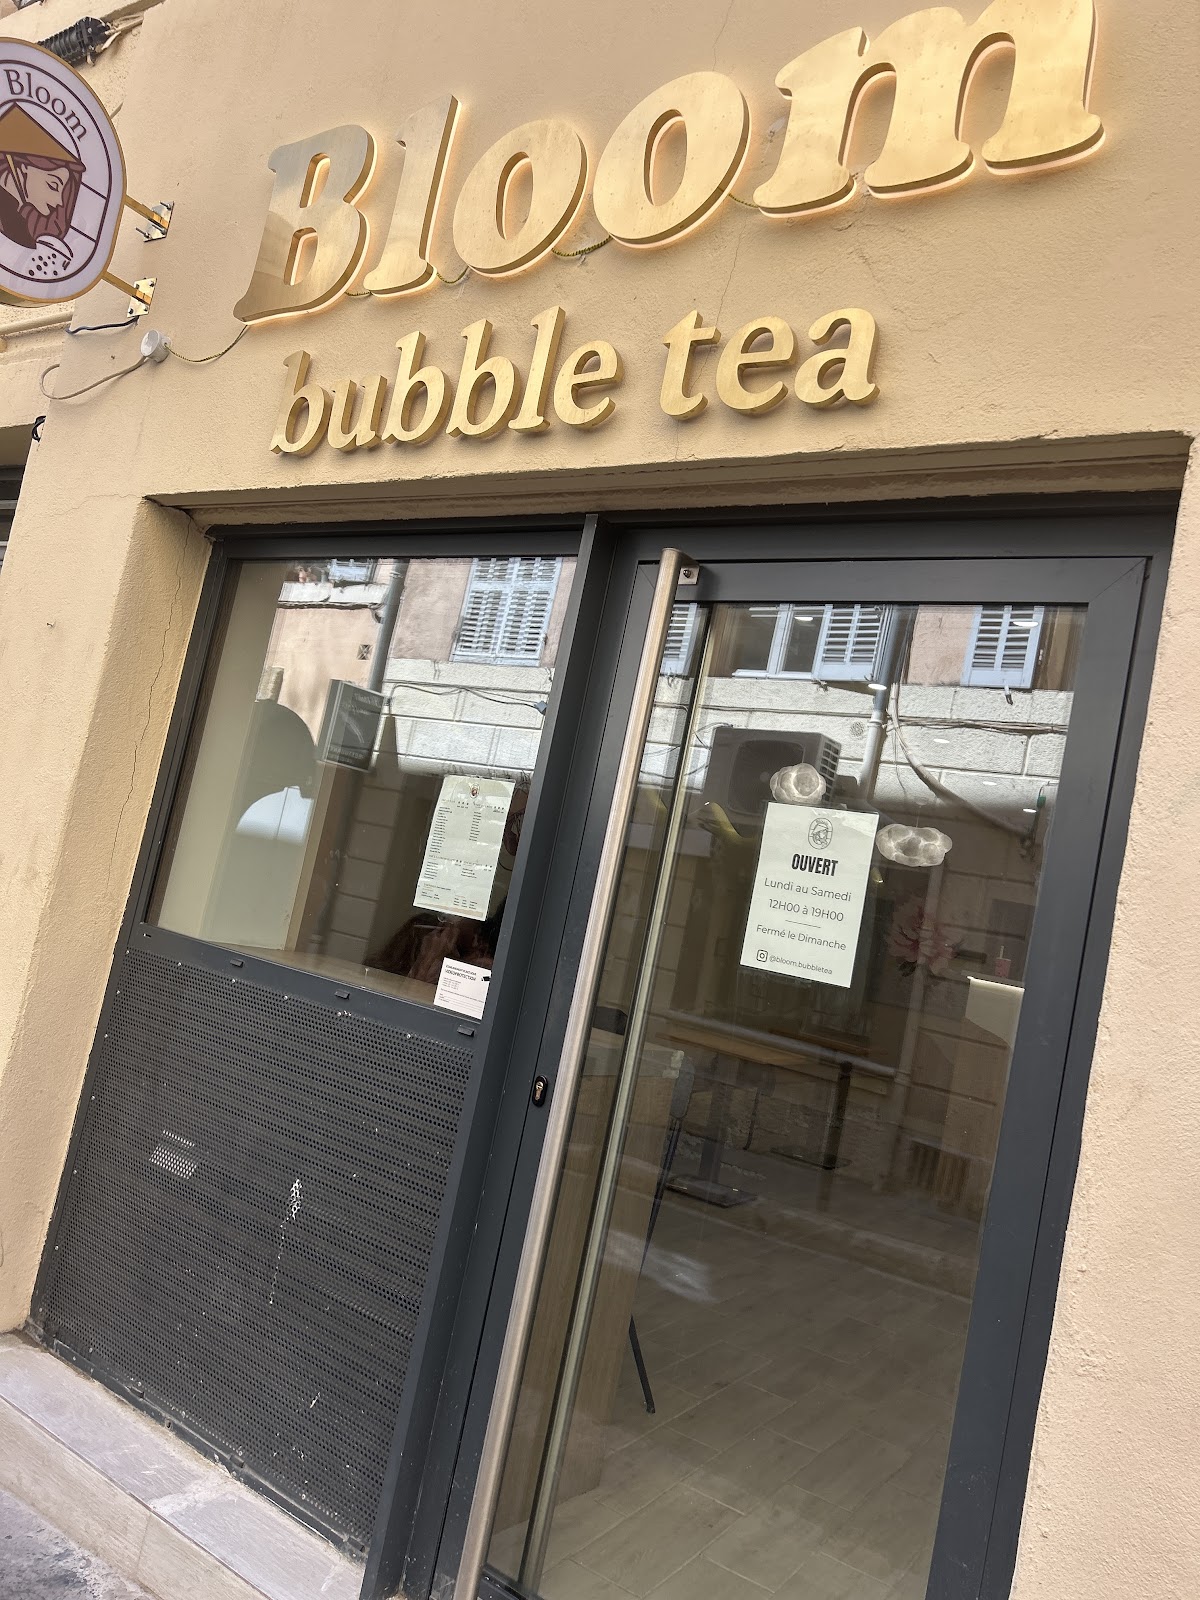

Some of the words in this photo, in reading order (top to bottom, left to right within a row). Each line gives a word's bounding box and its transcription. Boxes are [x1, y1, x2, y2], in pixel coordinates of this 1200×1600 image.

[4, 69, 89, 142] Bloom
[233, 0, 1106, 324] Bloom
[269, 306, 624, 456] bubble
[658, 307, 881, 421] tea
[791, 853, 839, 877] OUVERT
[764, 877, 794, 892] Lundi
[795, 883, 808, 894] au
[811, 886, 852, 902] Samedi
[768, 898, 800, 913] 12H00
[802, 905, 808, 915] à
[811, 906, 844, 922] 19H00
[756, 924, 786, 939] Fermé
[787, 930, 796, 940] le
[797, 932, 847, 951] Dimanche
[769, 954, 833, 975] @bloom.bubbletea
